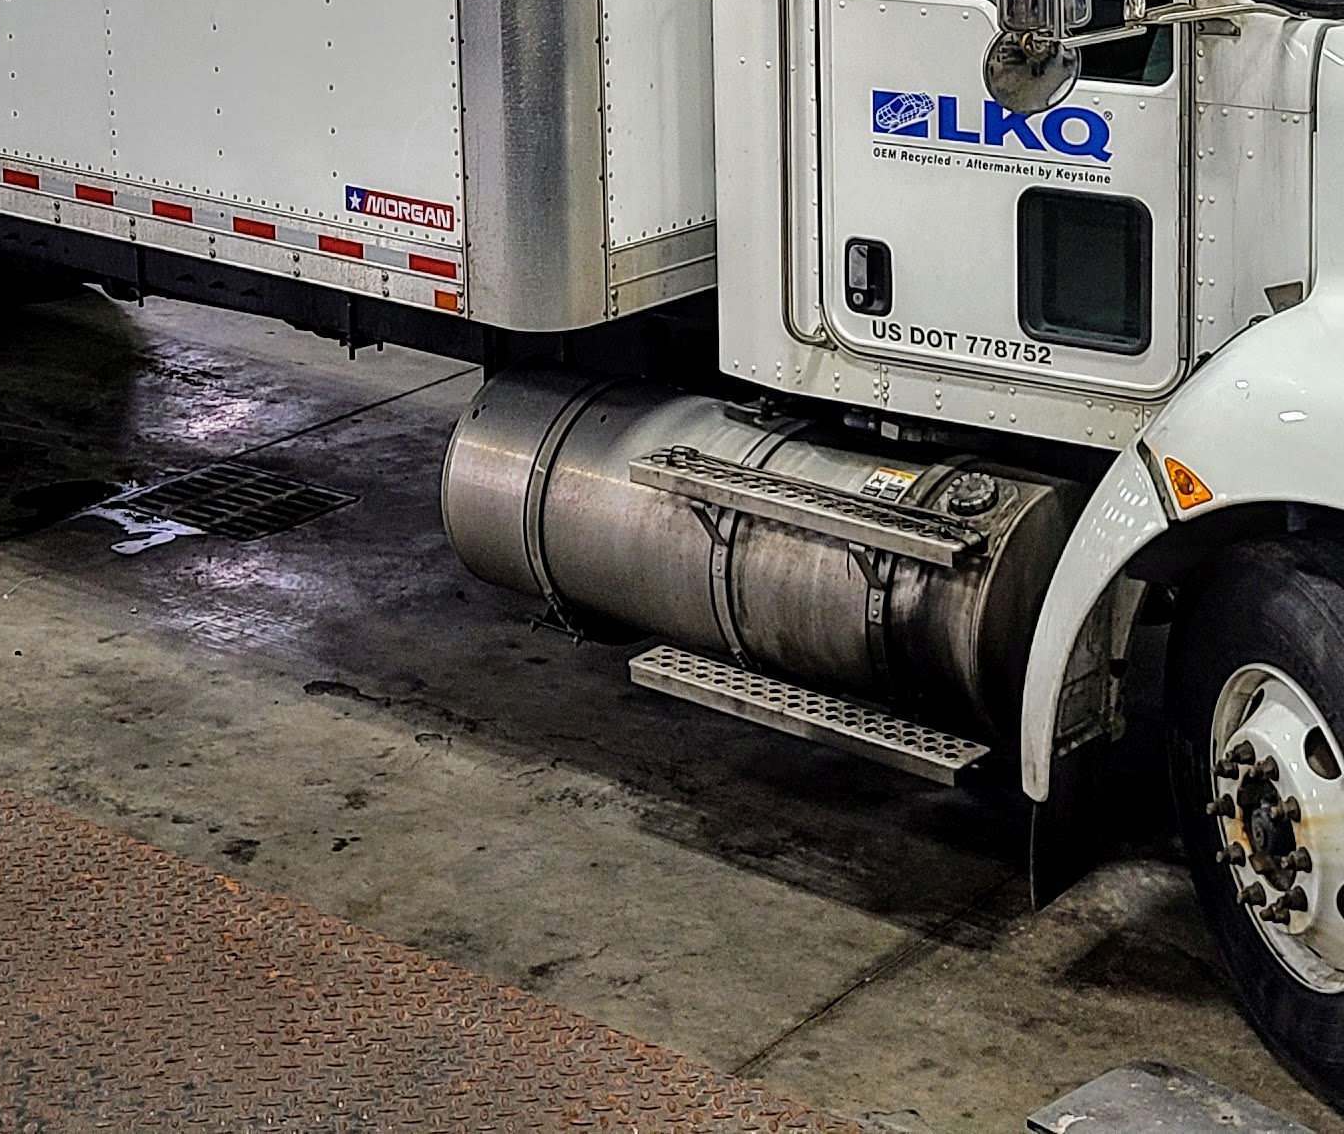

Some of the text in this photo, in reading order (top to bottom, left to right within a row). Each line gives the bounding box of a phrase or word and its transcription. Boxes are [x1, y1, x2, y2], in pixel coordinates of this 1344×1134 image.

[938, 94, 1113, 163] LKQ
[873, 147, 1112, 185] OEM Recycled Aftermarket by Keystone
[365, 194, 452, 229] MORGAN
[871, 320, 1053, 365] US DOT 778752
